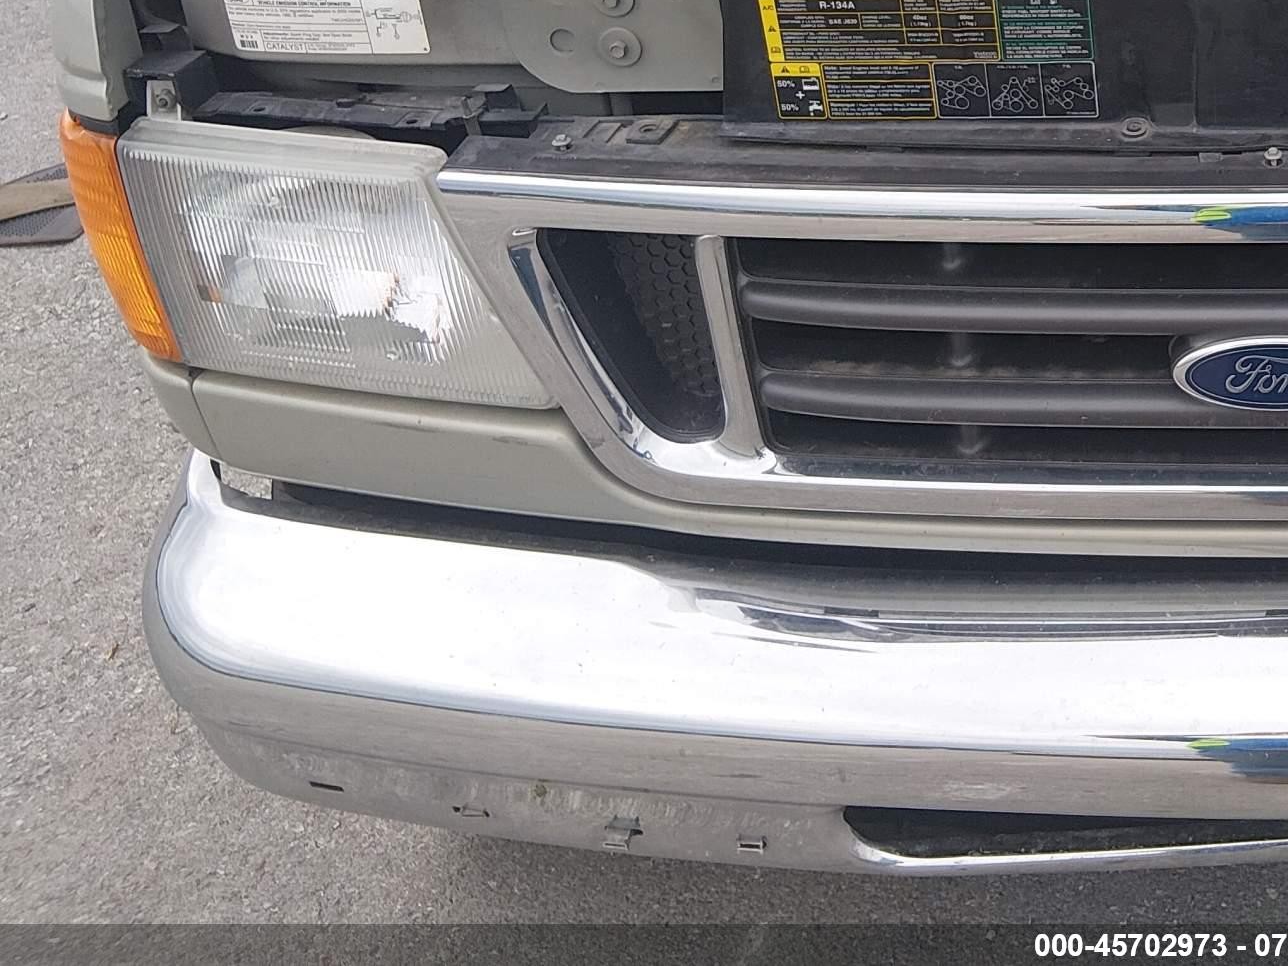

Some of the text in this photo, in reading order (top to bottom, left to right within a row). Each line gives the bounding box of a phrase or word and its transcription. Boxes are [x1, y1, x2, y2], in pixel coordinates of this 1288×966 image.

[819, 0, 856, 10] R-134A
[266, 43, 304, 51] CATALYST
[776, 80, 796, 88] 50%
[781, 103, 800, 112] 50%
